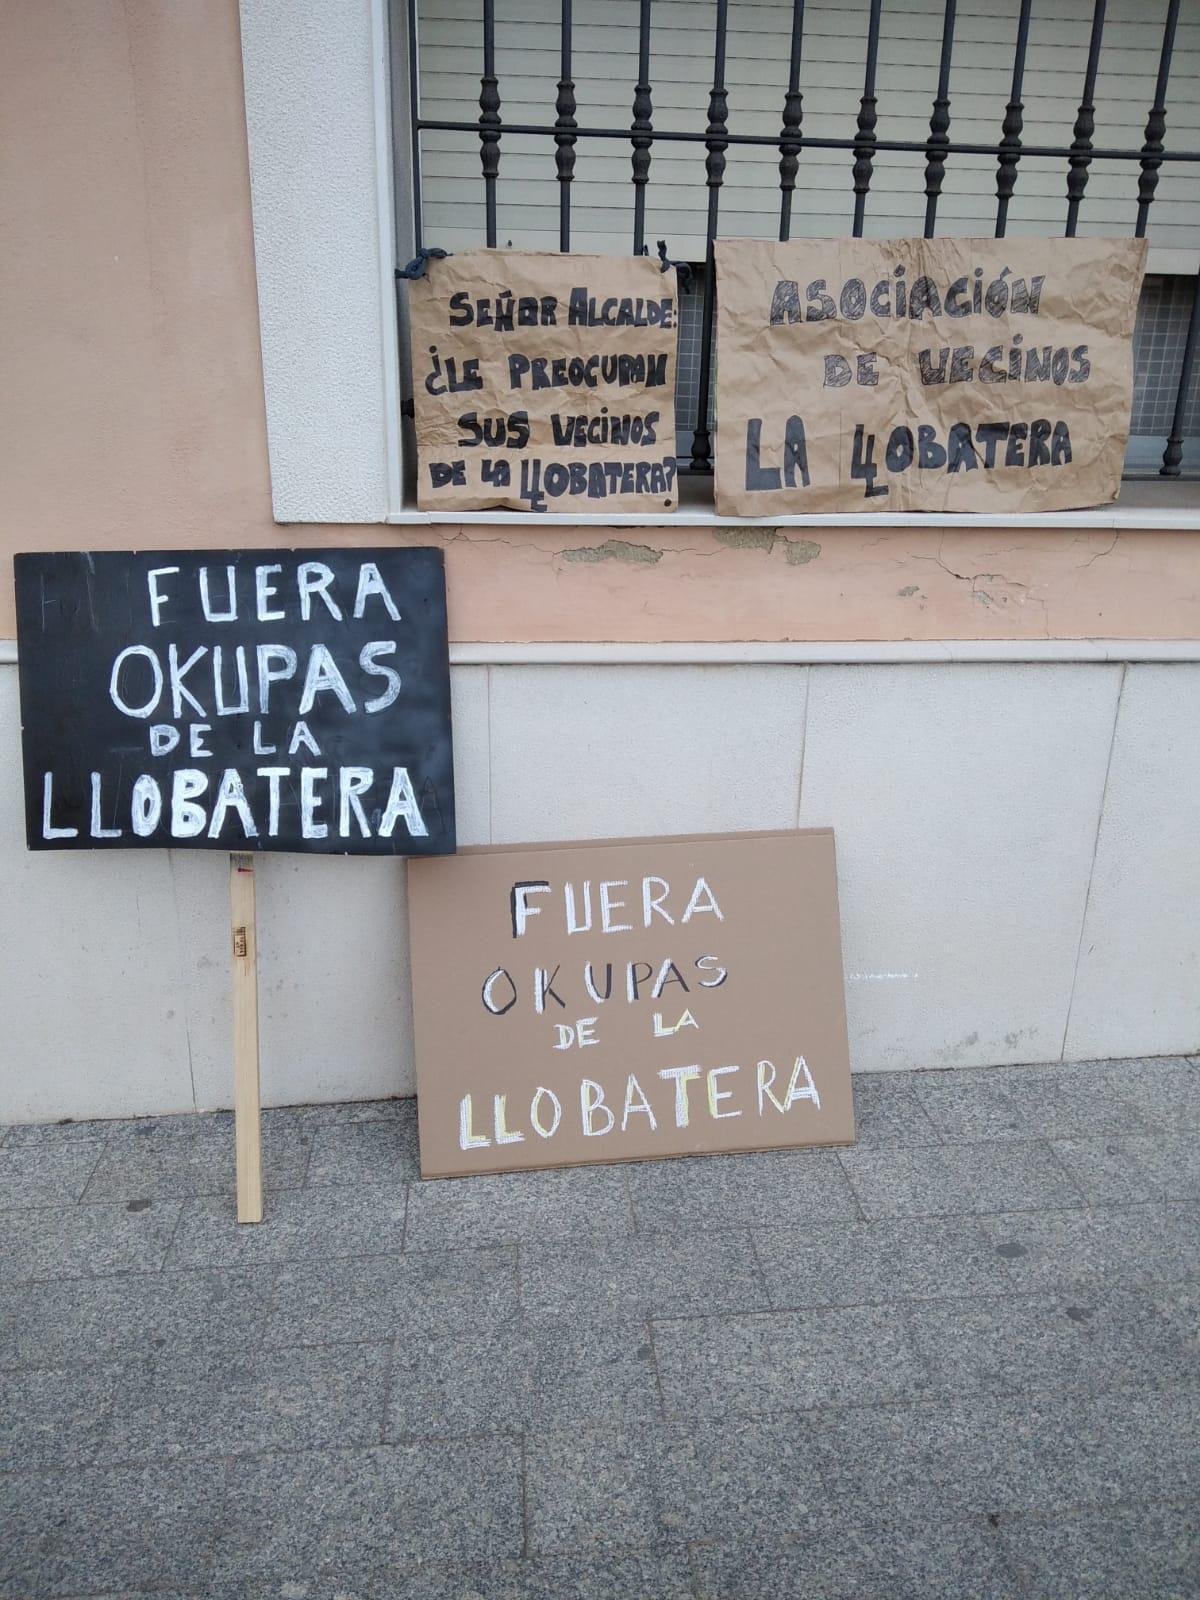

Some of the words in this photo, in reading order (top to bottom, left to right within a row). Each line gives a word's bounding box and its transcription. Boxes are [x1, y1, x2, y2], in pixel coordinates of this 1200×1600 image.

[450, 290, 558, 332] SEÑOR
[425, 346, 483, 395] ¿LE
[508, 354, 667, 390] PREOCUPAN
[823, 351, 879, 388] DE
[458, 411, 530, 449] SUS
[745, 415, 810, 491] LA
[850, 419, 1072, 498] LLOBATERA
[429, 460, 466, 488] DE
[481, 459, 511, 487] LA
[147, 562, 401, 626] FUERA
[109, 640, 402, 718] OKUPAS
[149, 723, 213, 758] DE
[253, 720, 322, 756] LA
[42, 767, 429, 839] LLOBATERA
[511, 876, 724, 938] FUERA
[481, 955, 728, 1015] OKUPAS
[552, 1017, 600, 1050] DE
[653, 1009, 700, 1037] LA
[459, 1055, 821, 1150] LLOBATERA
